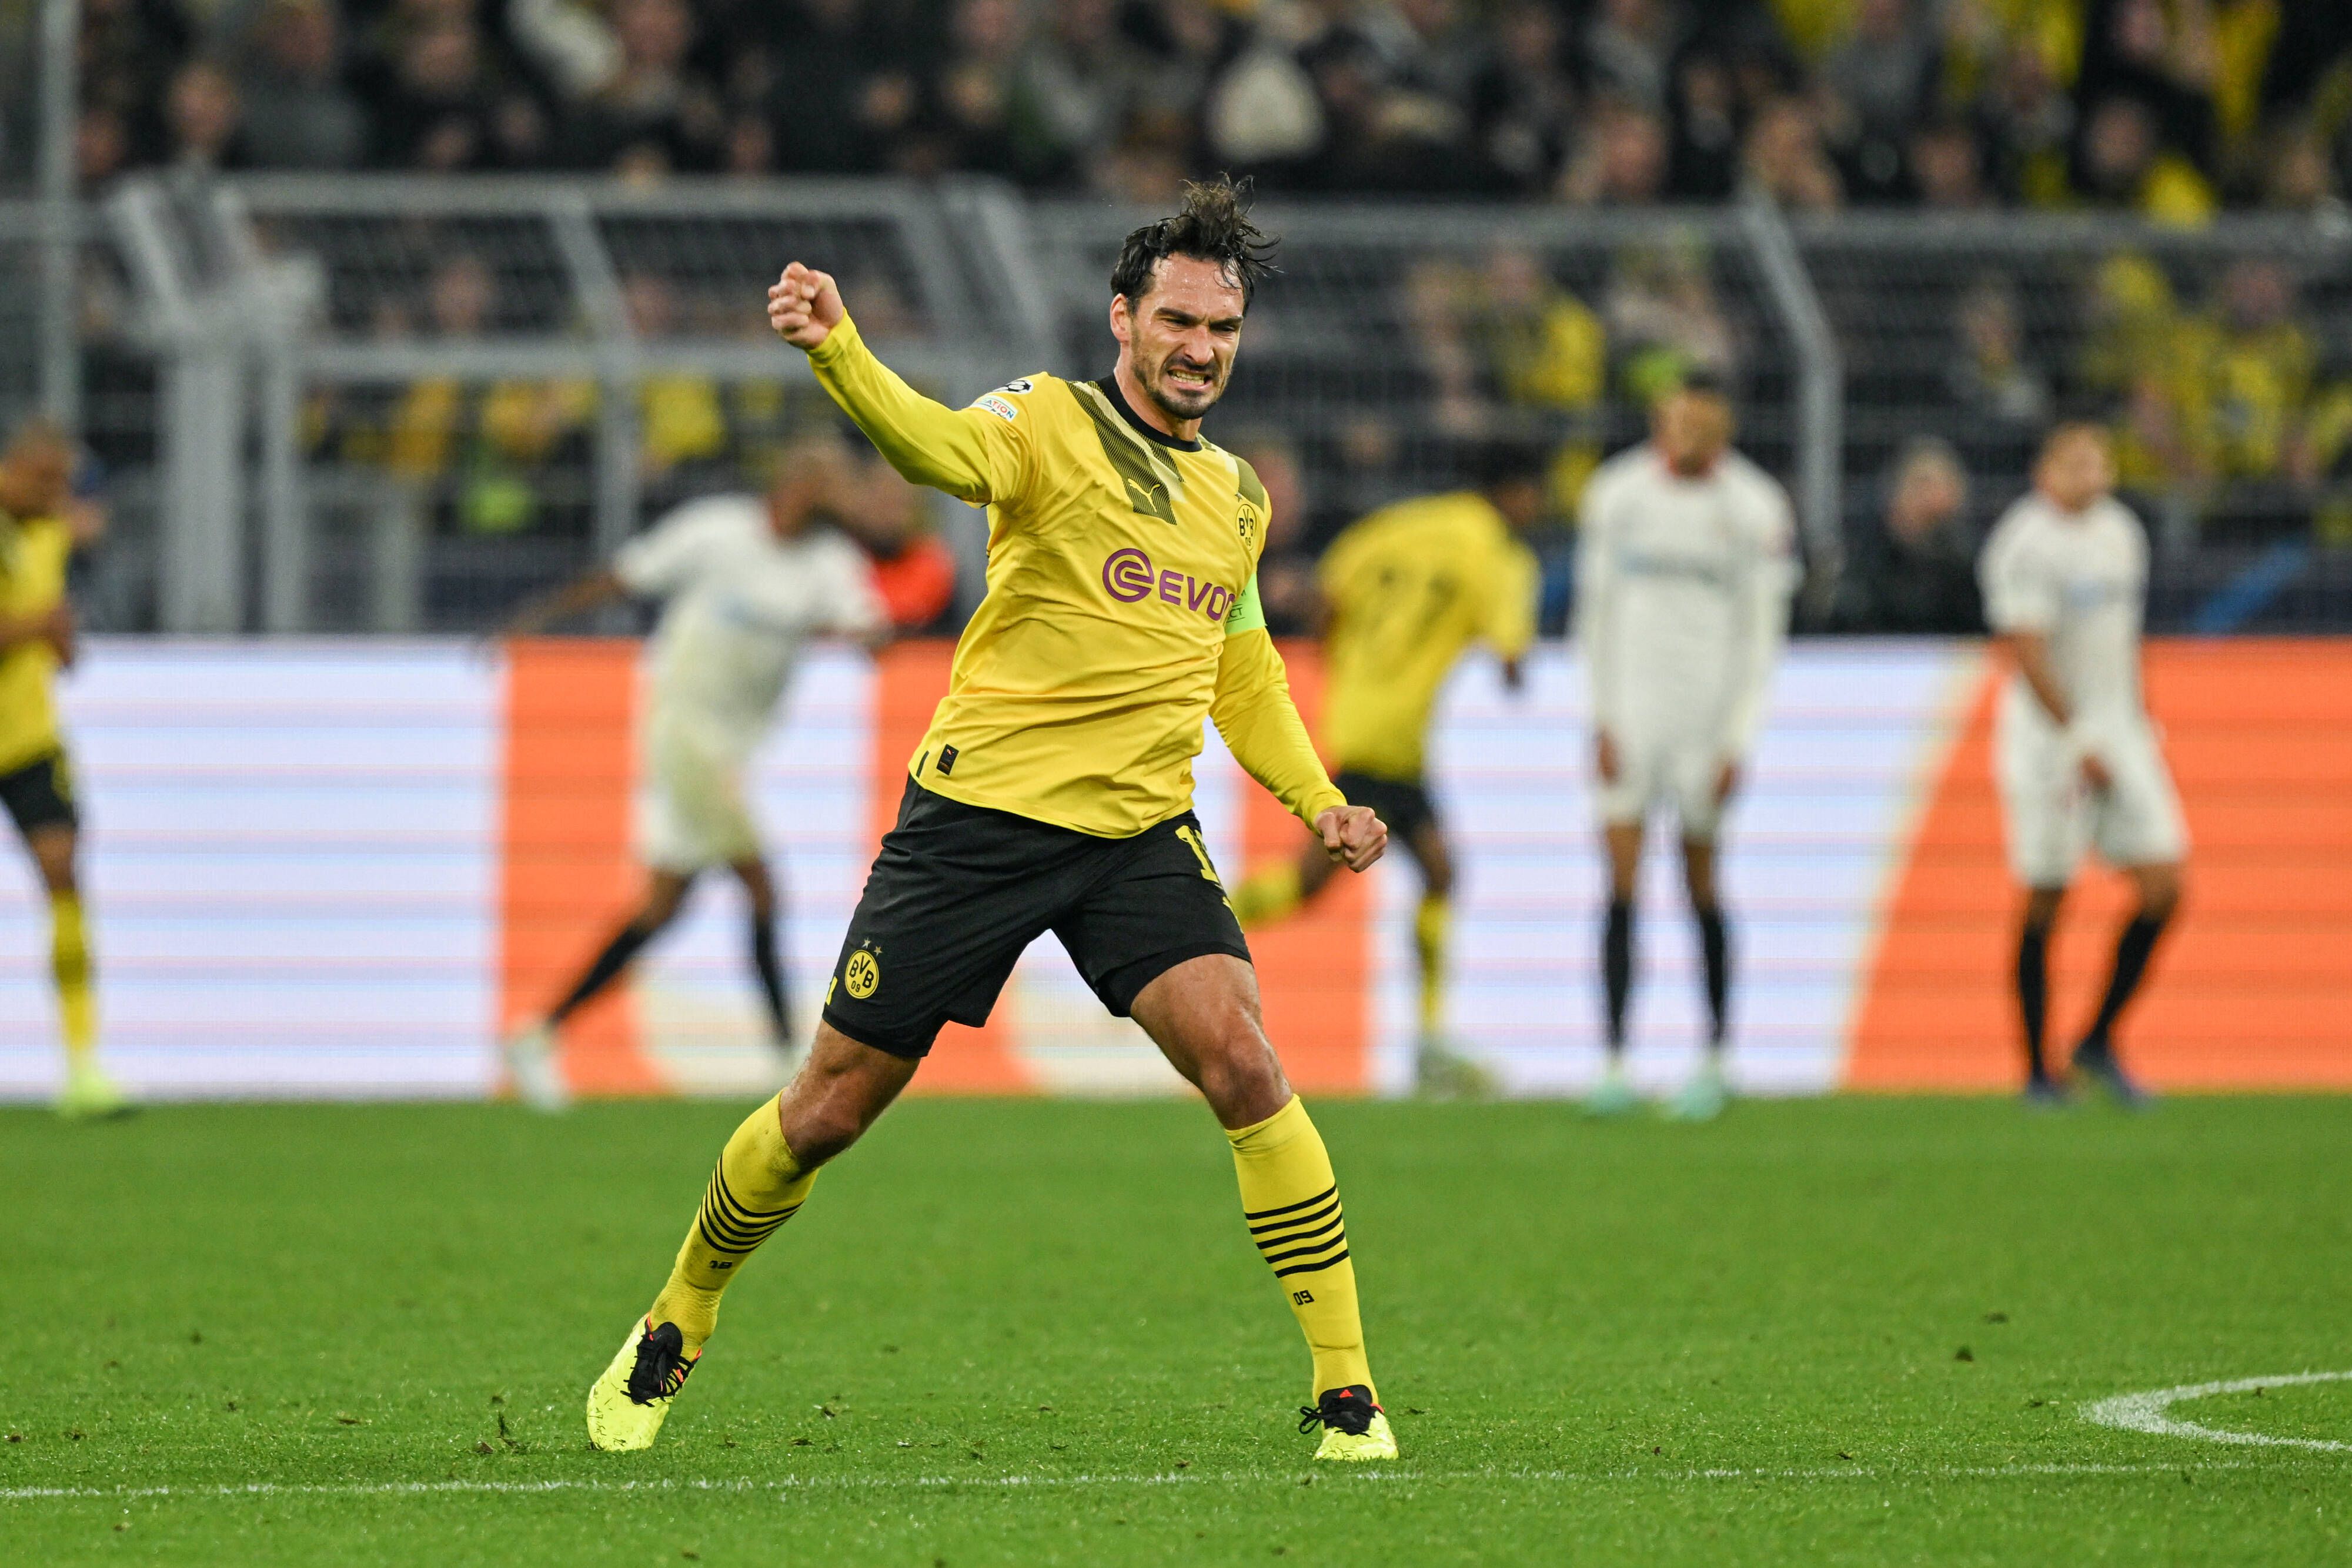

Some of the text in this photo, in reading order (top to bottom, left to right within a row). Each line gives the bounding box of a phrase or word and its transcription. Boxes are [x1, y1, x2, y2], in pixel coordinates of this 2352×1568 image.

[1238, 509, 1254, 537] BVB
[848, 954, 874, 988] BVB
[851, 980, 861, 992] 09
[1293, 1290, 1315, 1305] 09
